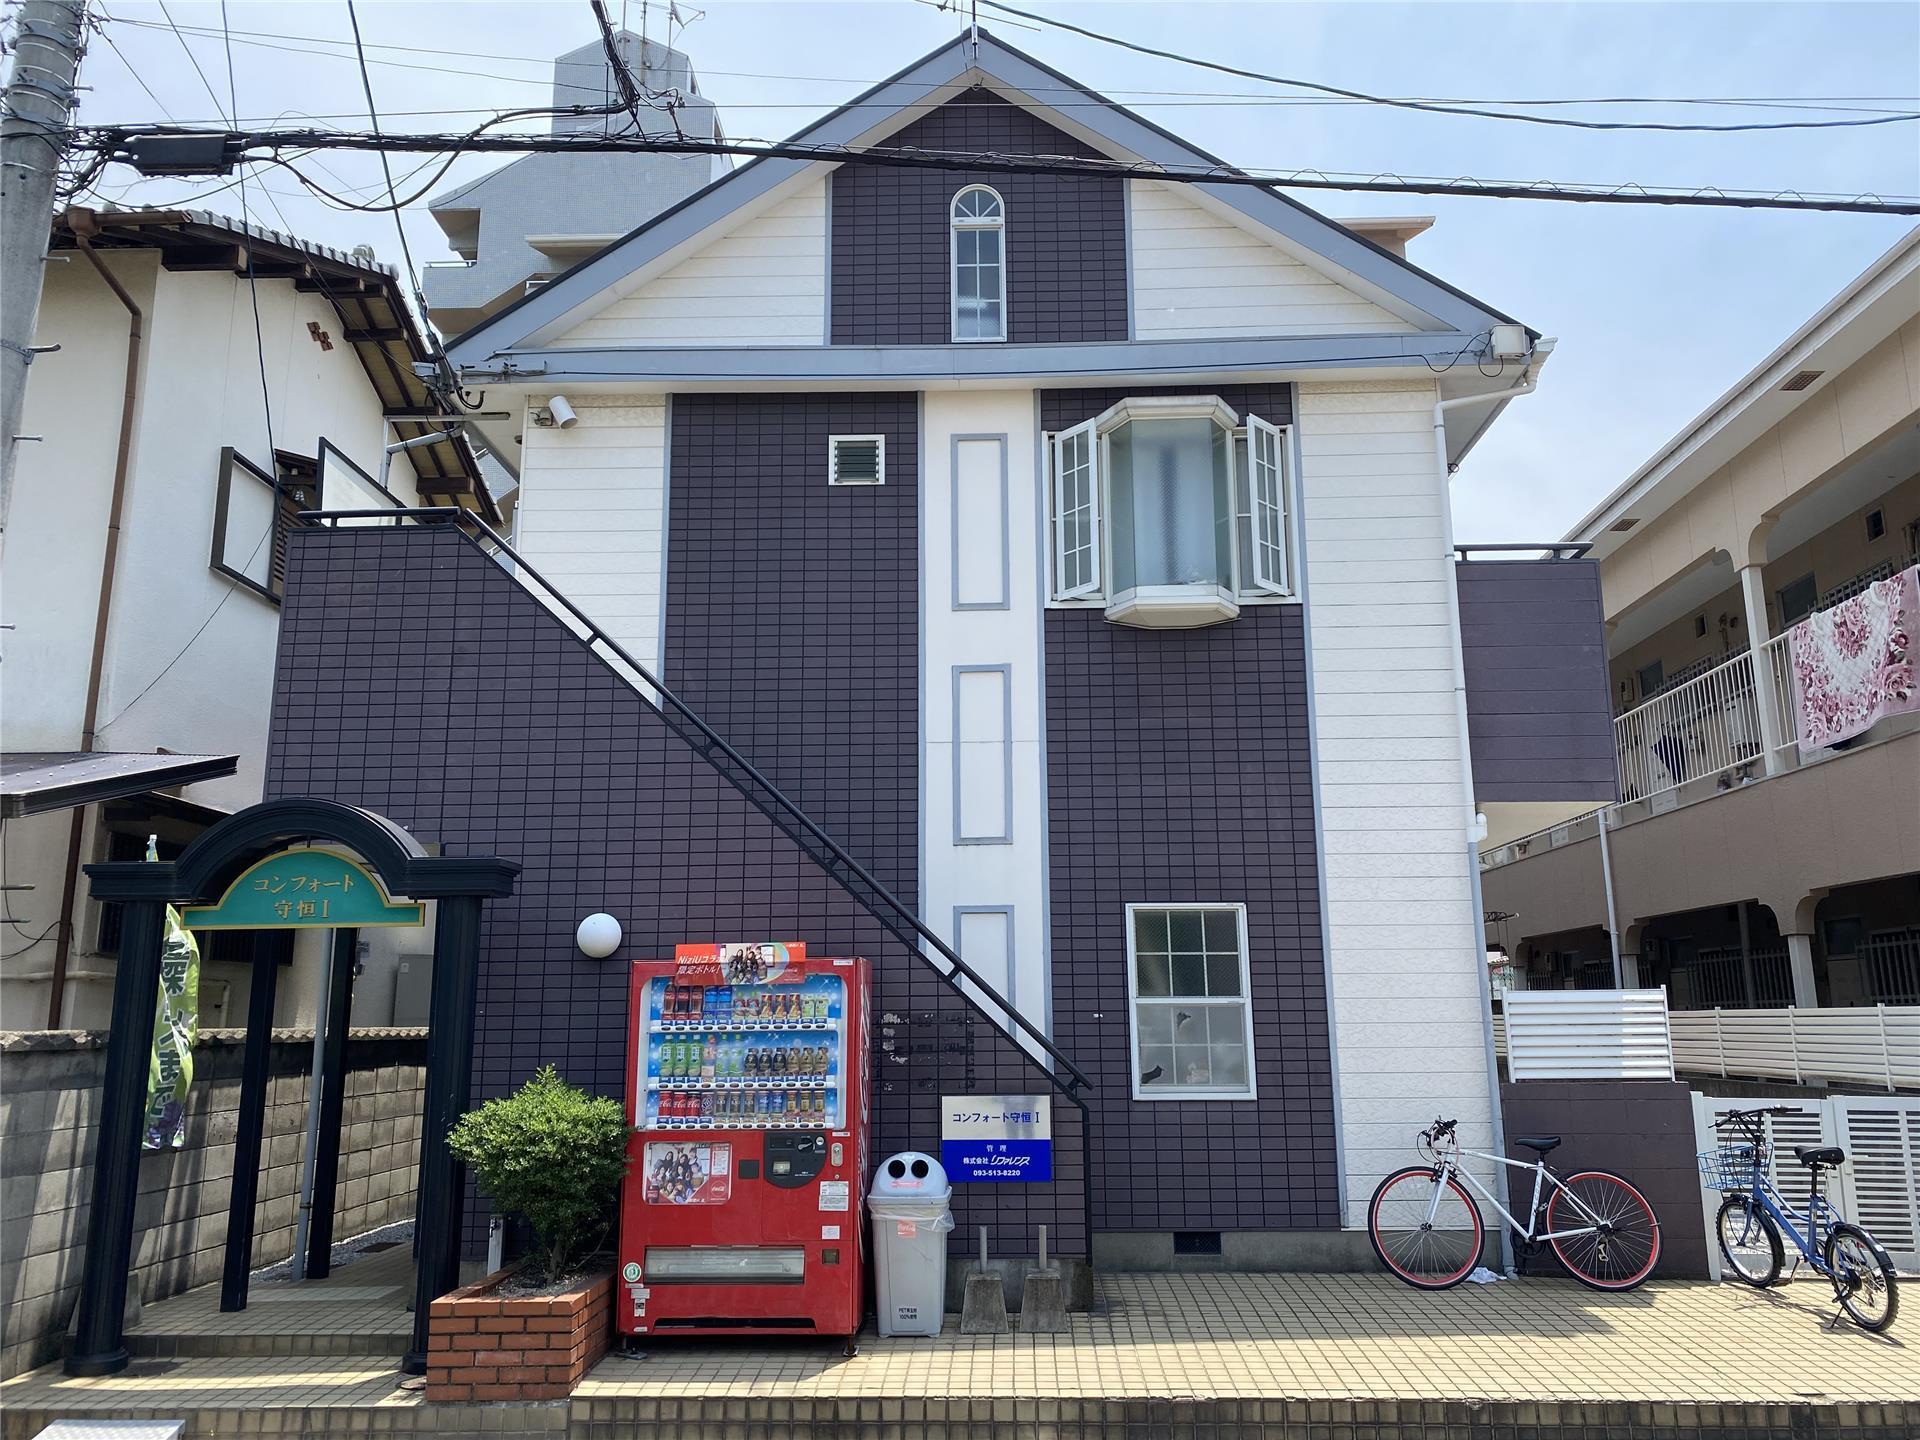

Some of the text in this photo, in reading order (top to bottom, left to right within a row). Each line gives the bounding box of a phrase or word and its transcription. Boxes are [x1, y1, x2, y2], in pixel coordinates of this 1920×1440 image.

[254, 874, 354, 894] コンフォート
[973, 1169, 1021, 1177] 093-513-8220
